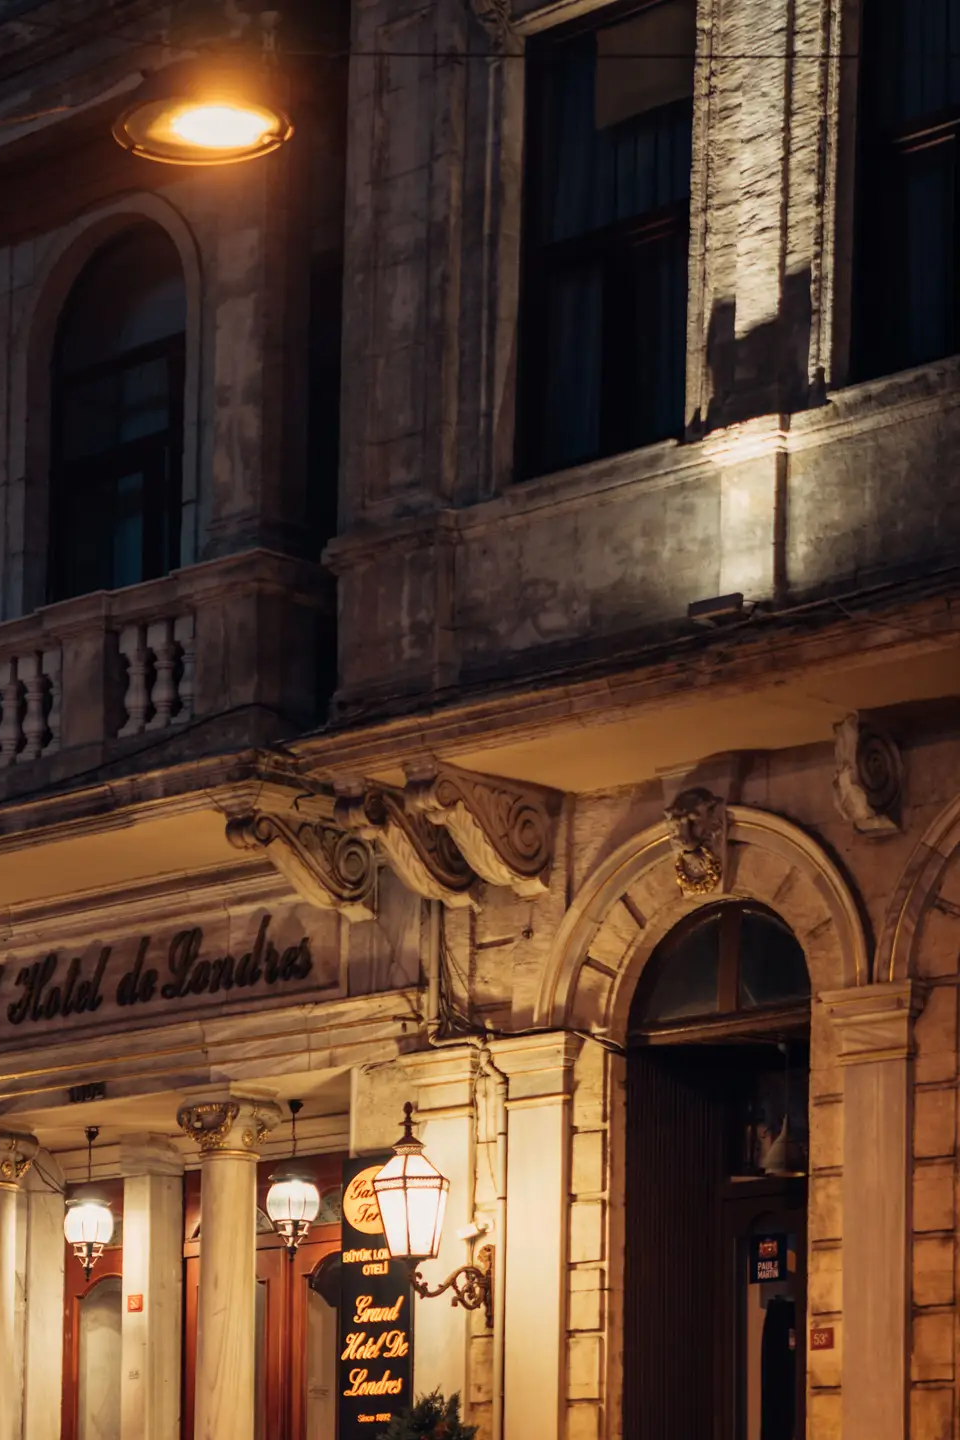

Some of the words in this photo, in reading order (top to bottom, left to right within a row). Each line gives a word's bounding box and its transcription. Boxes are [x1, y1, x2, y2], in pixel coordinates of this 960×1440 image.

[7, 946, 112, 1024] Hotel
[116, 936, 159, 1002] de
[160, 915, 313, 1000] Londres
[354, 1203, 380, 1223] Ter
[342, 1248, 373, 1263] BÜYÜK
[353, 1295, 405, 1323] Grand
[341, 1331, 388, 1360] Hotel
[383, 1330, 409, 1358] De
[343, 1368, 403, 1397] Londres
[357, 1413, 375, 1422] Since
